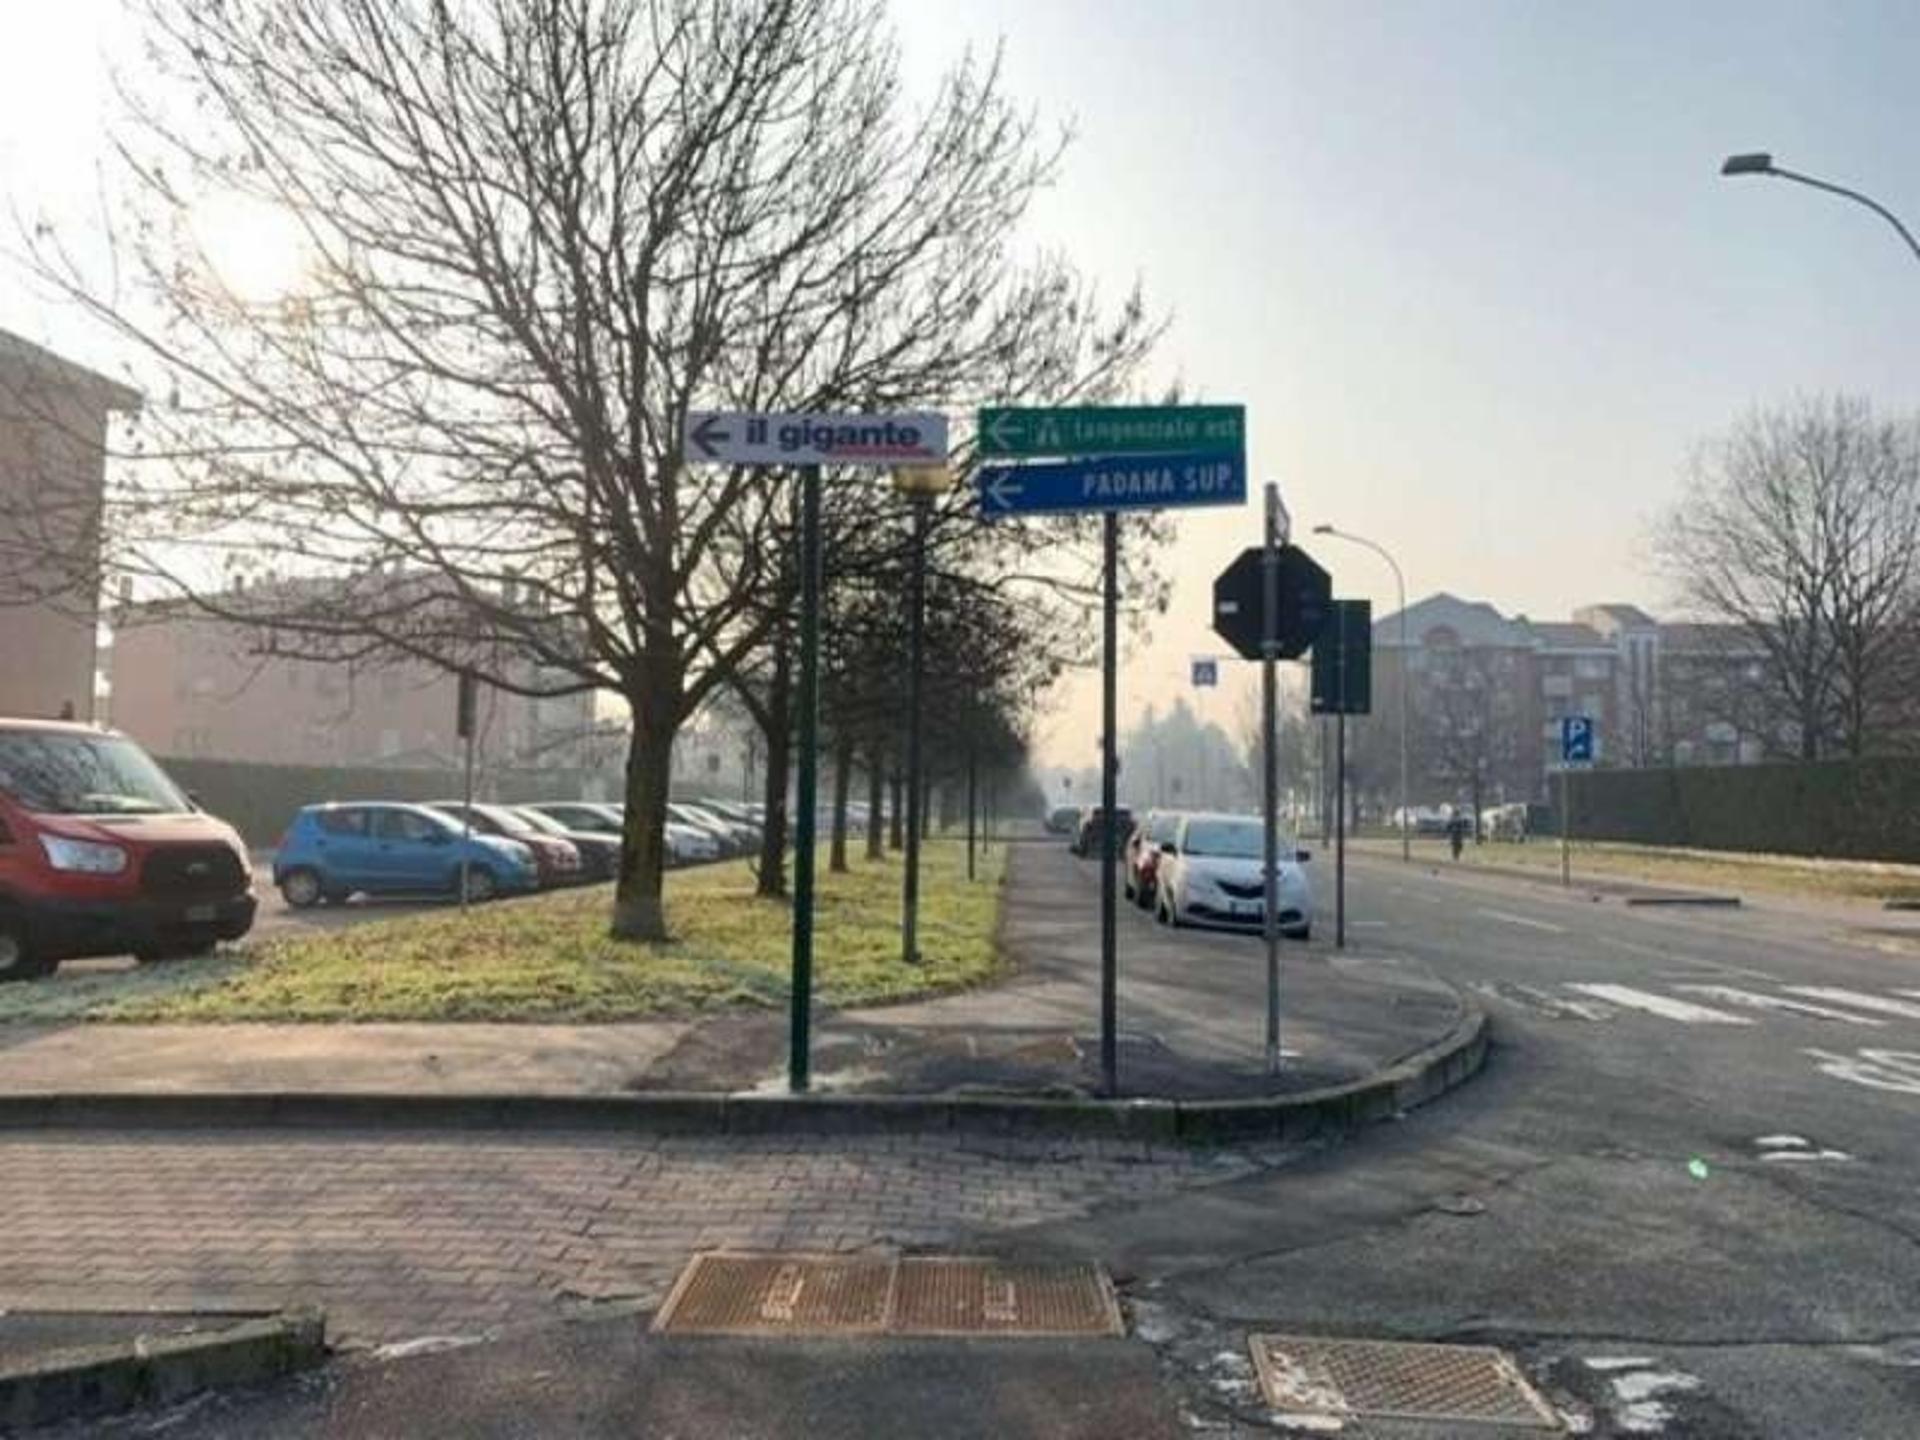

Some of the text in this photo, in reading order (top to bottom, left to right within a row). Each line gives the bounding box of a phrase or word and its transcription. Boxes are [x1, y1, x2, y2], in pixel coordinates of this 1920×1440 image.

[746, 419, 922, 453] il gigante
[1082, 467, 1173, 496] PADANA
